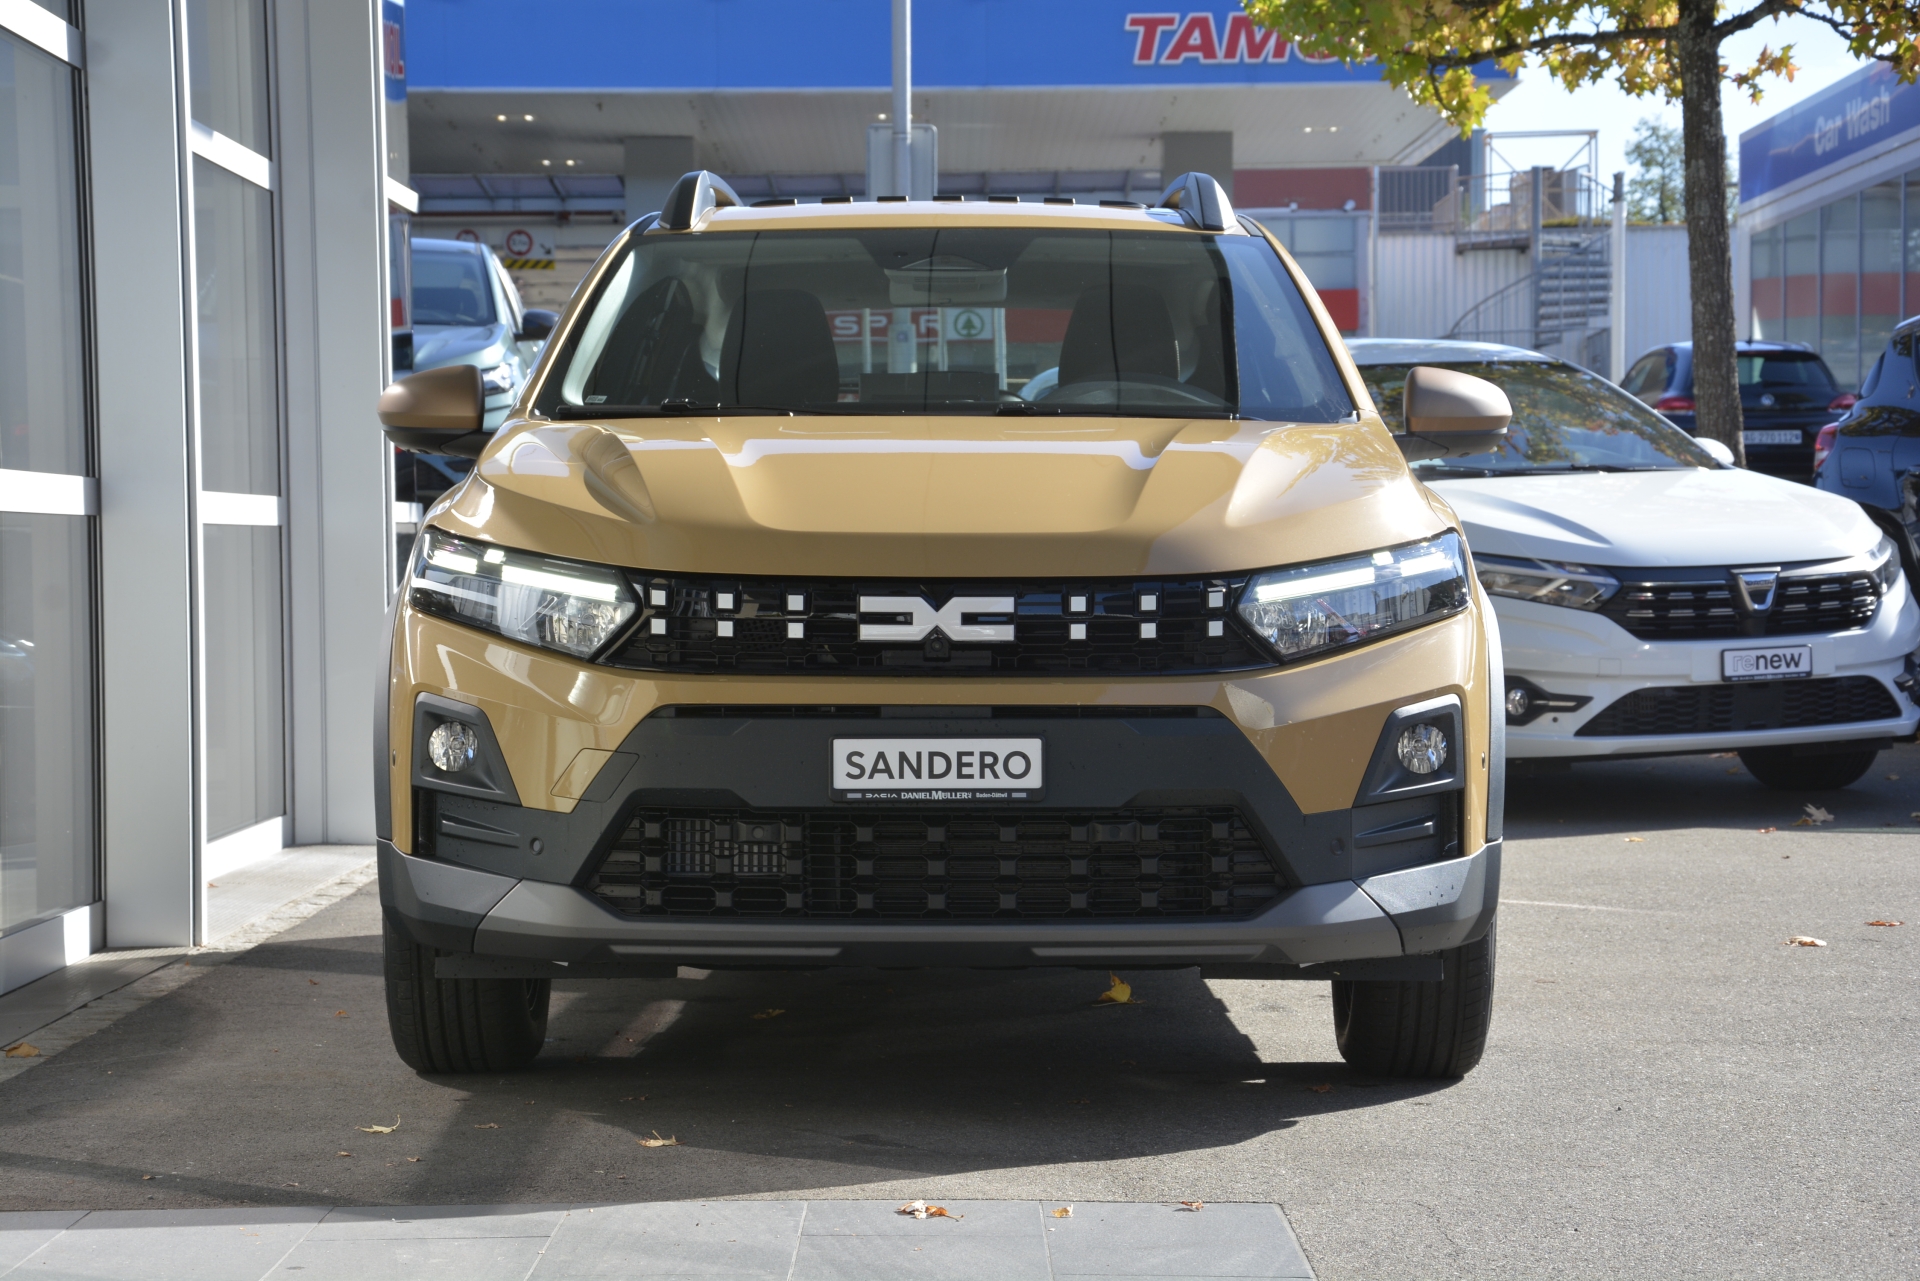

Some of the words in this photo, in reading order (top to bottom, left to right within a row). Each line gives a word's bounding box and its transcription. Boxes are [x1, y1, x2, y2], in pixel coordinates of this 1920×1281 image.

[1125, 12, 1378, 64] TAM
[1815, 115, 1842, 156] Car
[1846, 85, 1890, 140] Wash
[834, 314, 939, 335] SPR
[1733, 652, 1803, 672] renew
[845, 750, 1032, 780] SANDERO
